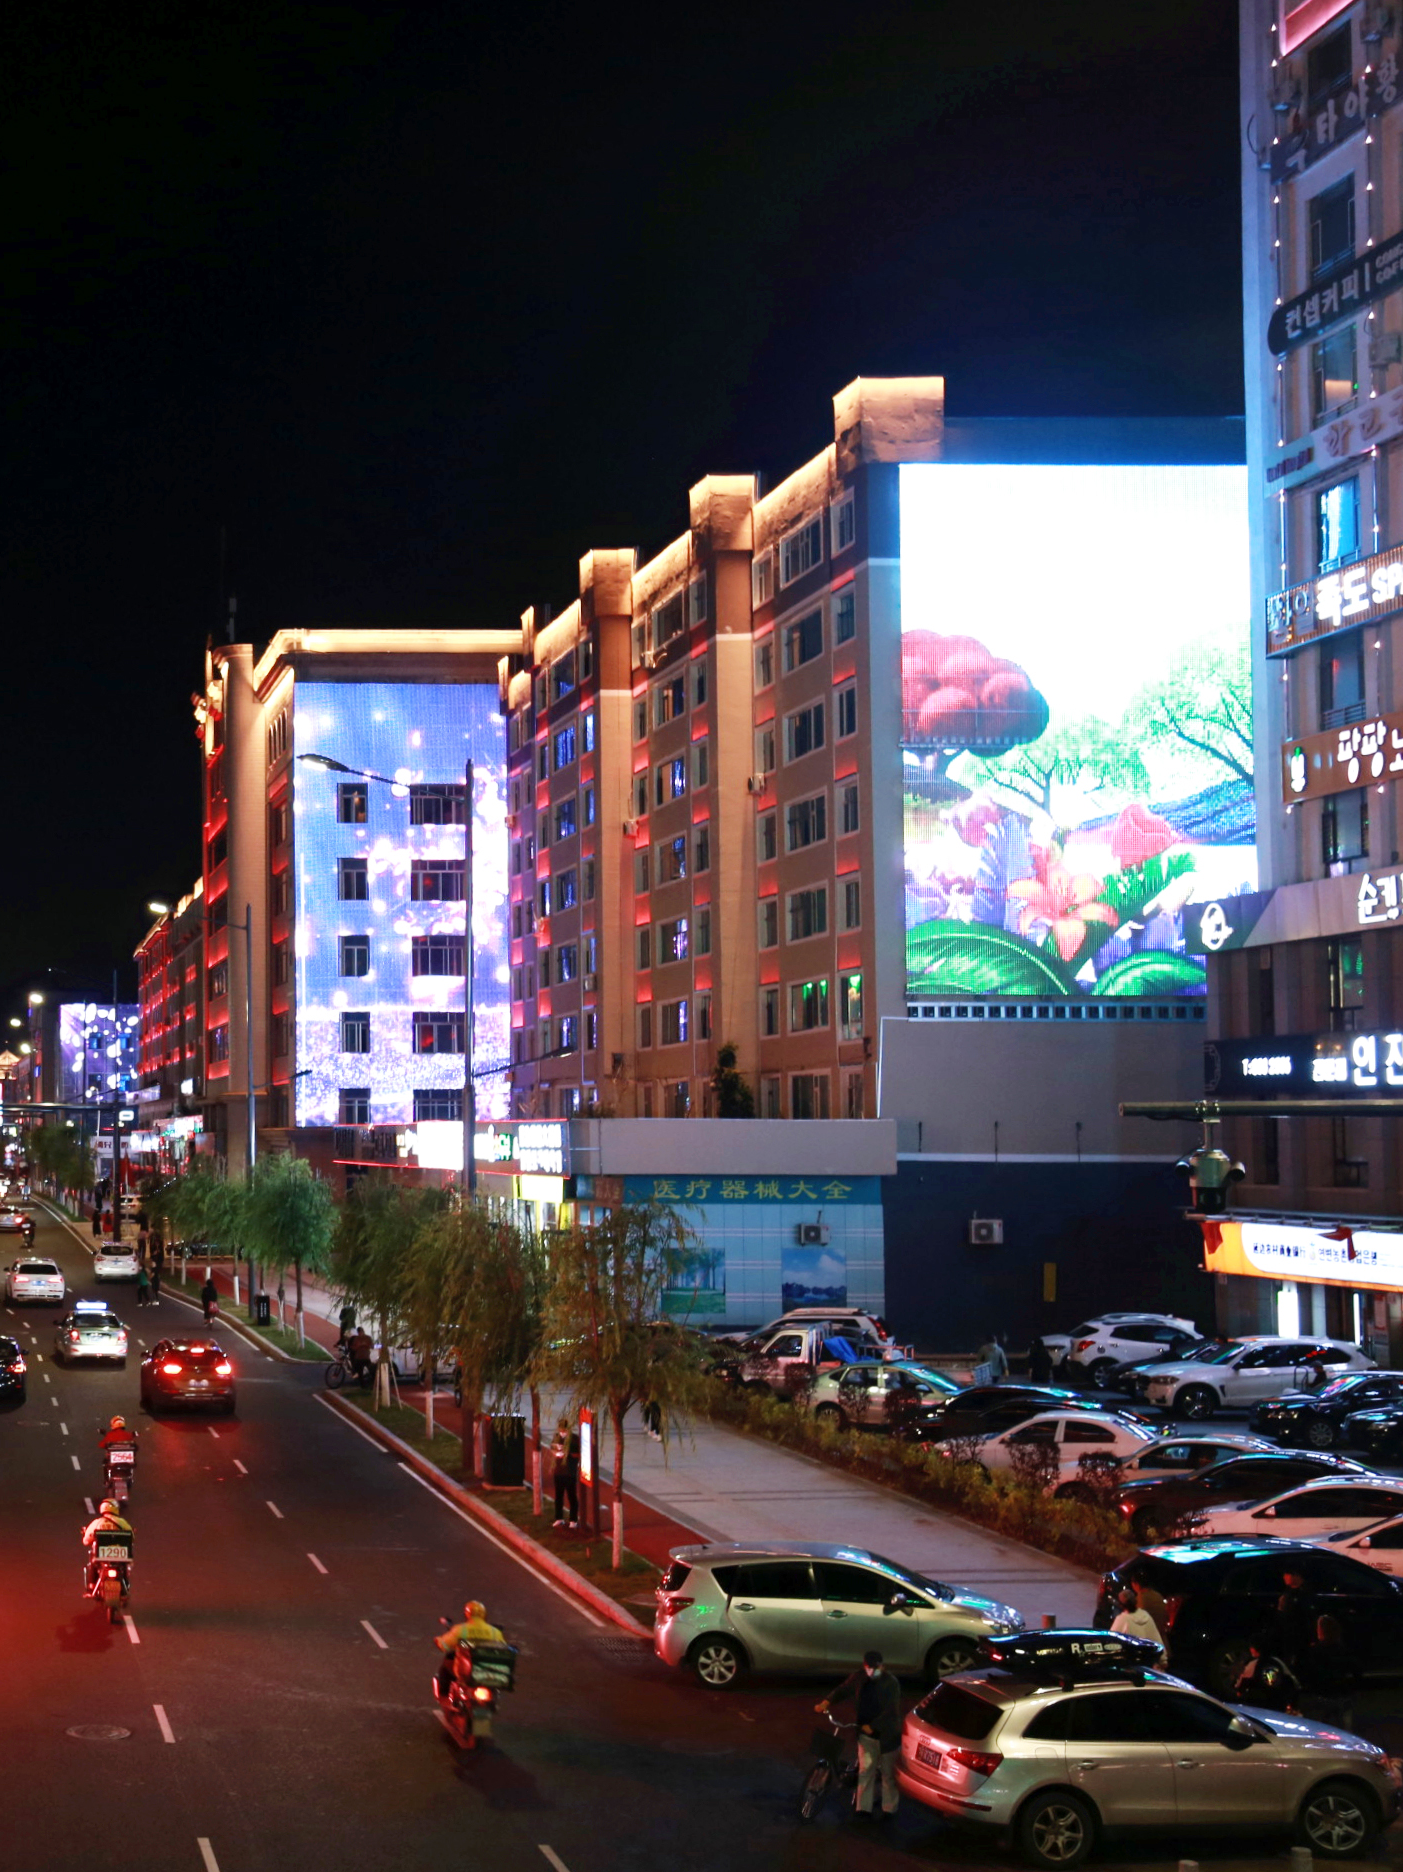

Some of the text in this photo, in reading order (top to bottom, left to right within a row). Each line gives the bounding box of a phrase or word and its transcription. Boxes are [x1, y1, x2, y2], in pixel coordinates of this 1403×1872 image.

[1284, 268, 1360, 340] 컨셉커피
[653, 1178, 853, 1200] 医疗器械大全
[100, 1547, 127, 1559] 1290
